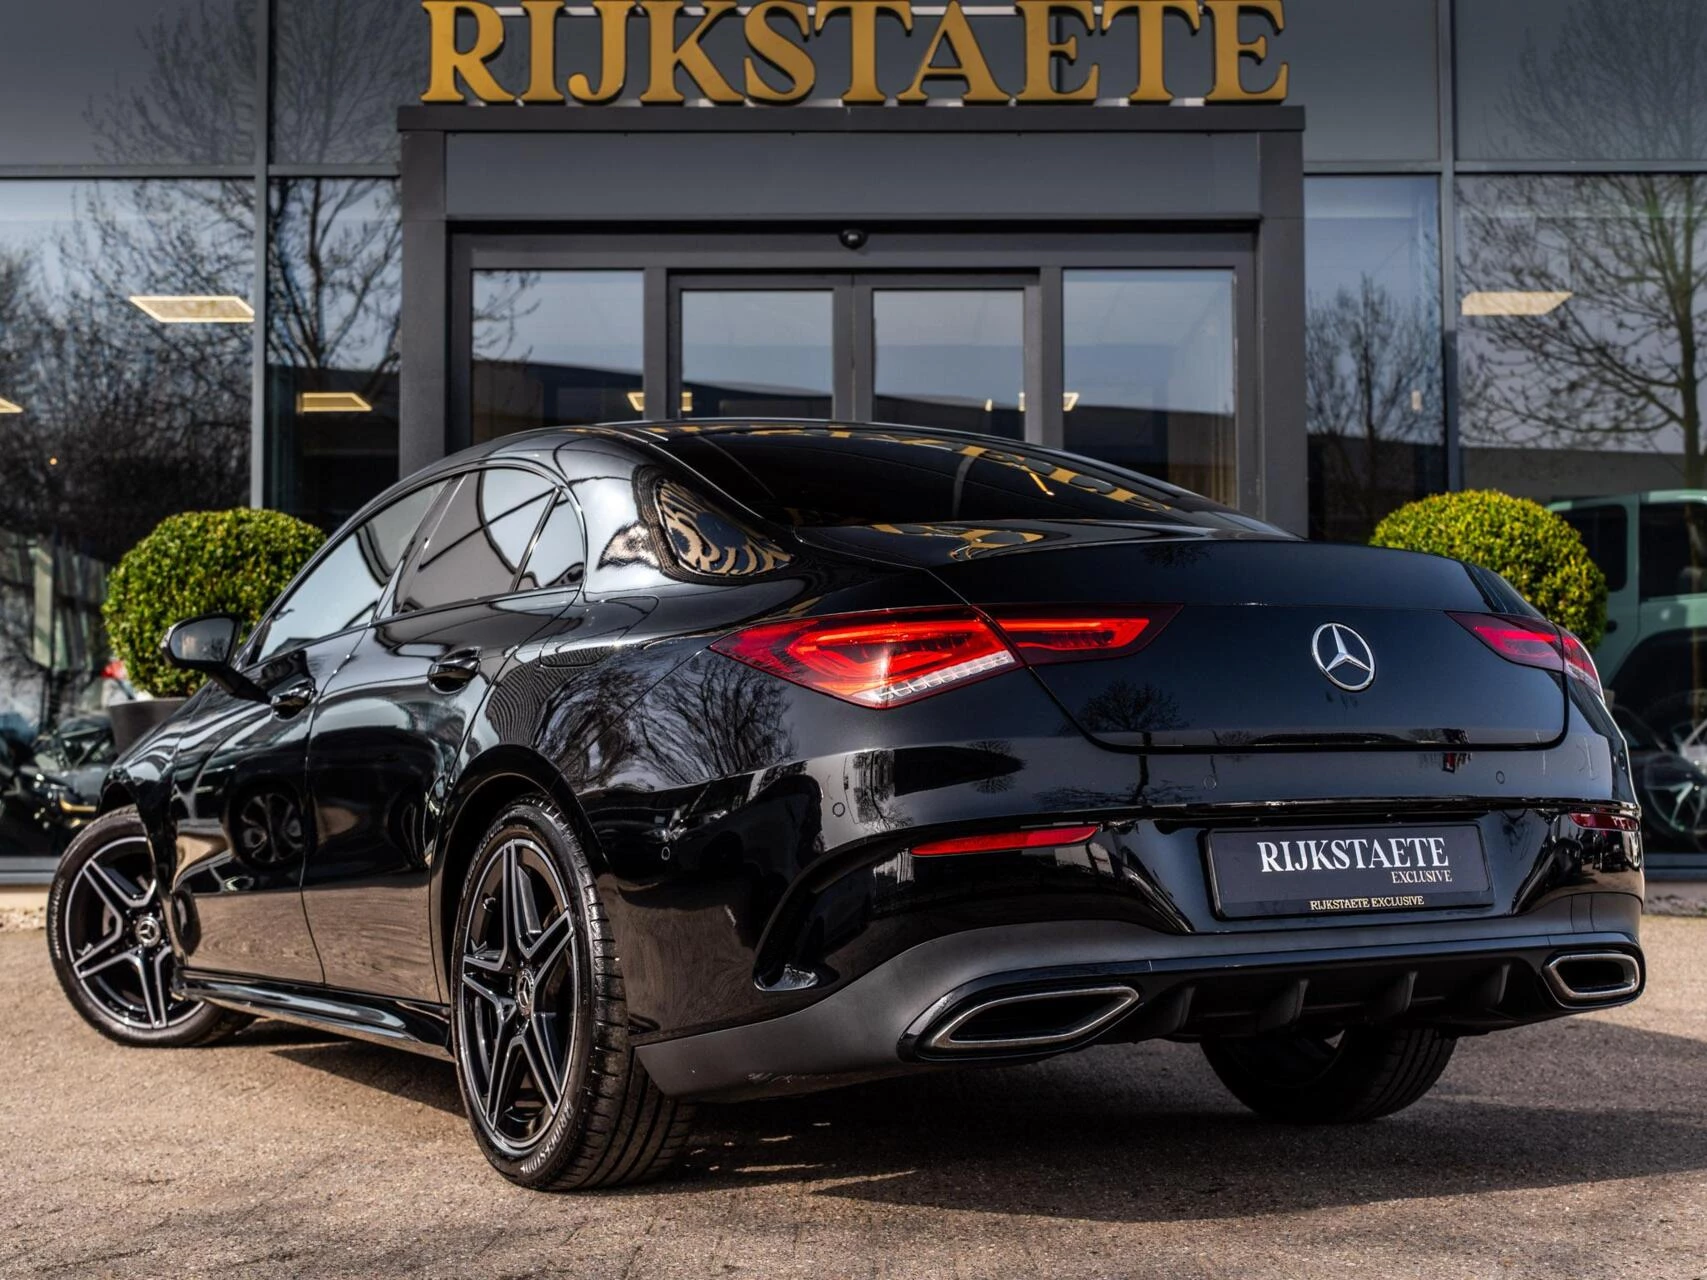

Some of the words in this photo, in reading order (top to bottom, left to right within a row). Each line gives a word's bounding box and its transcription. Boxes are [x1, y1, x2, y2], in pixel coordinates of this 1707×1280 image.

[420, 0, 1289, 102] RIJKSTAETE
[1257, 837, 1449, 873] RIJKSTAETE
[1391, 870, 1453, 884] EXCLUSIVE
[1310, 898, 1370, 911] RIJKSTAETE
[1371, 895, 1425, 907] EXCLUSIVE
